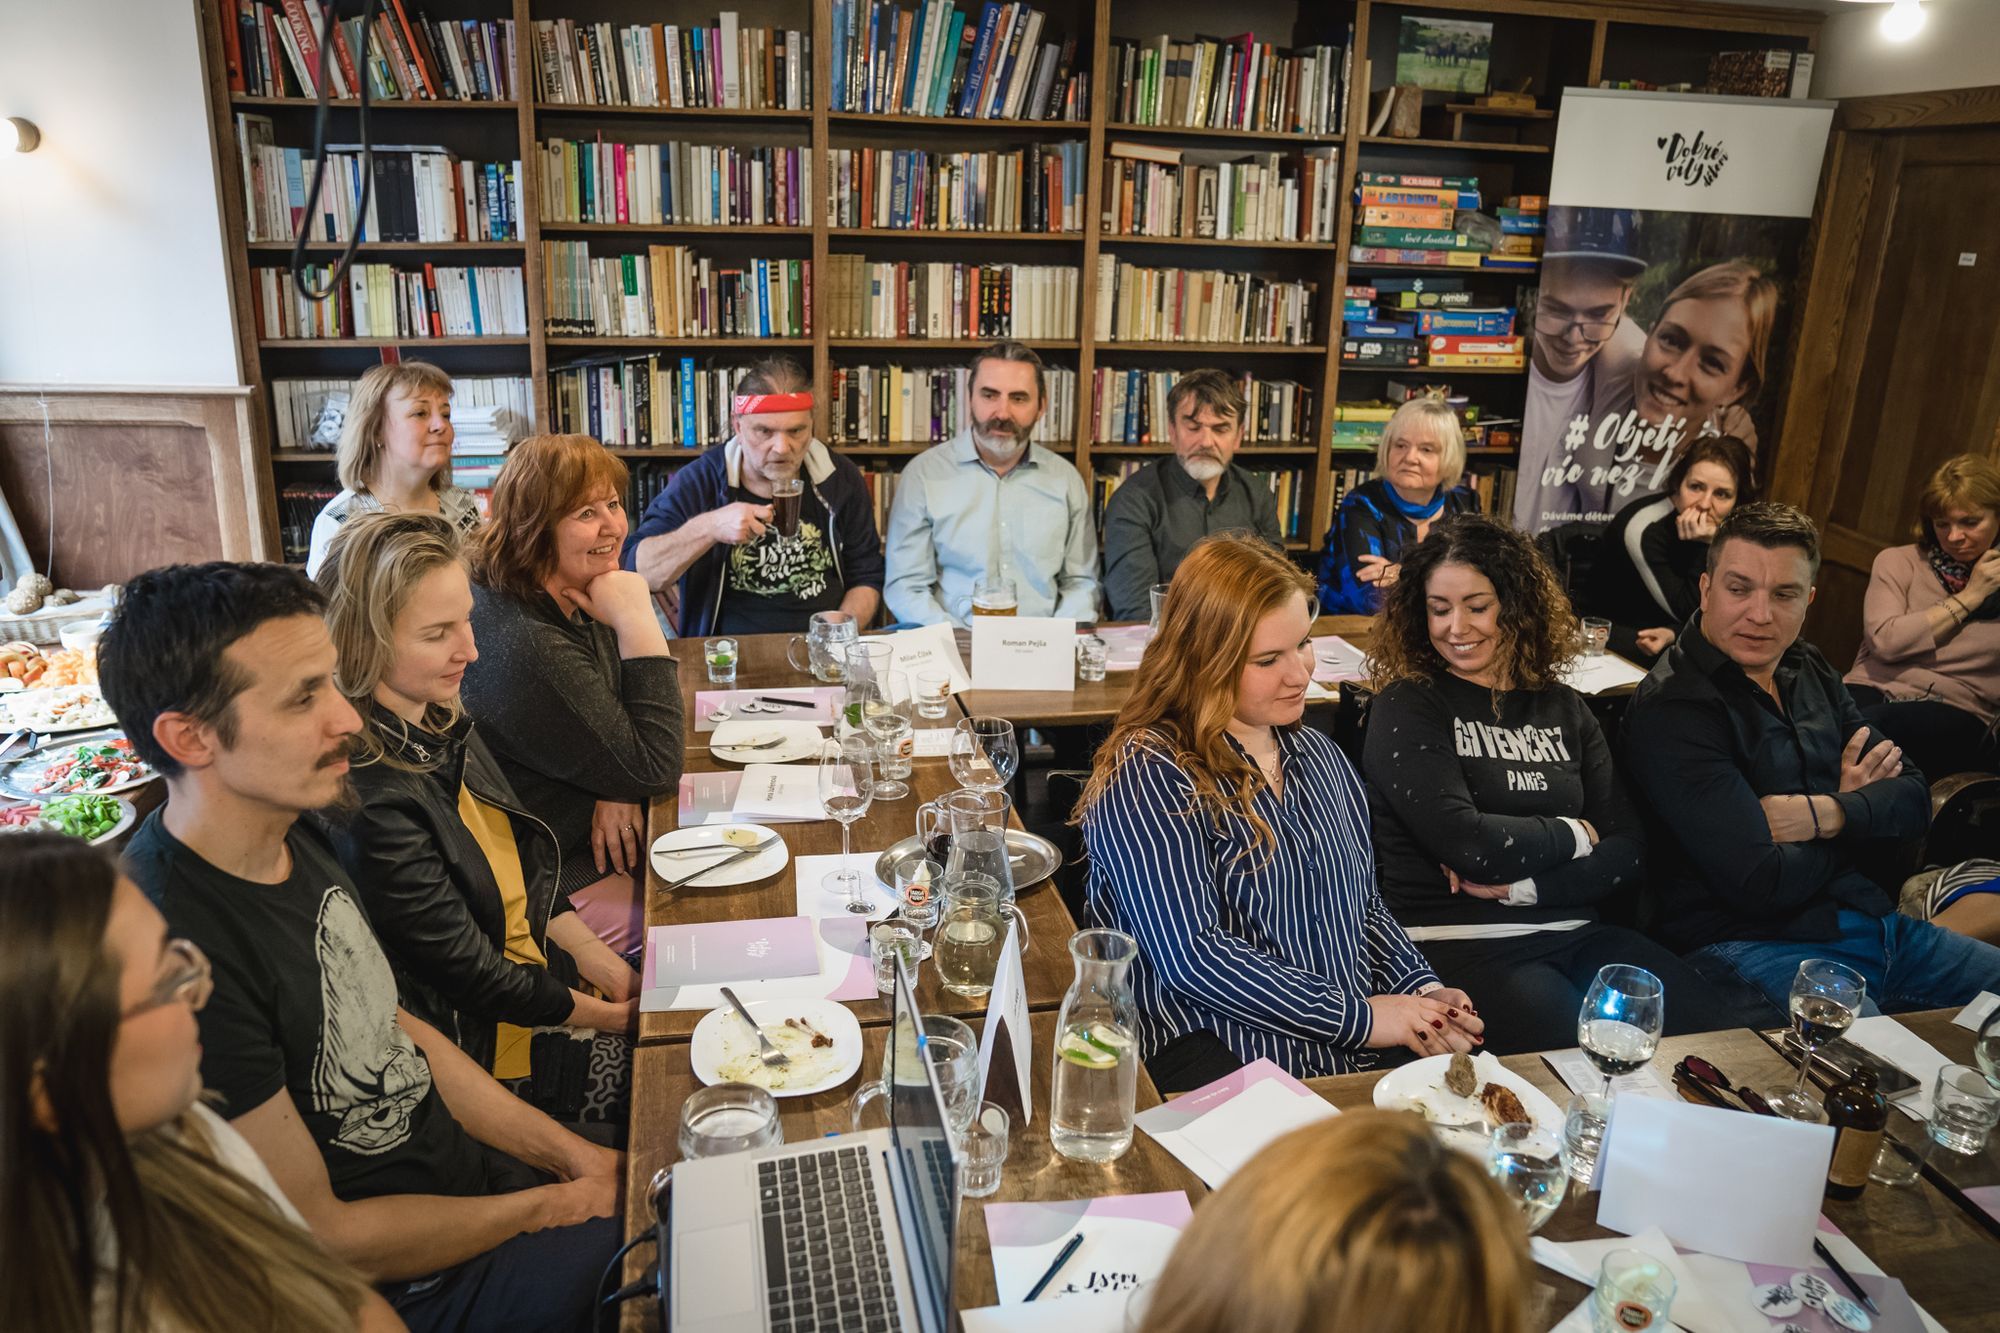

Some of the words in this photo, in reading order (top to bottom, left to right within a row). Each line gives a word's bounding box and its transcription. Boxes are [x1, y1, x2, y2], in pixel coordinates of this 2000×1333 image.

[284, 0, 313, 55] COOKING
[986, 7, 999, 30] Česká
[539, 31, 550, 63] KOONTZ
[545, 73, 556, 95] DEAN
[1666, 130, 1723, 164] Dobré
[1401, 176, 1442, 186] SCRABBLE
[1666, 157, 1704, 186] víly
[1379, 192, 1438, 205] LABYRINTH
[1440, 293, 1470, 304] nimble
[1564, 413, 1590, 450] #
[1593, 409, 1687, 462] Objetí
[1541, 455, 1584, 487] víc
[1590, 454, 1646, 497] než
[1541, 510, 1584, 522] Dáváme
[1002, 639, 1027, 648] Roman
[899, 653, 917, 663] Milan
[1455, 717, 1571, 761] GIVENCHY
